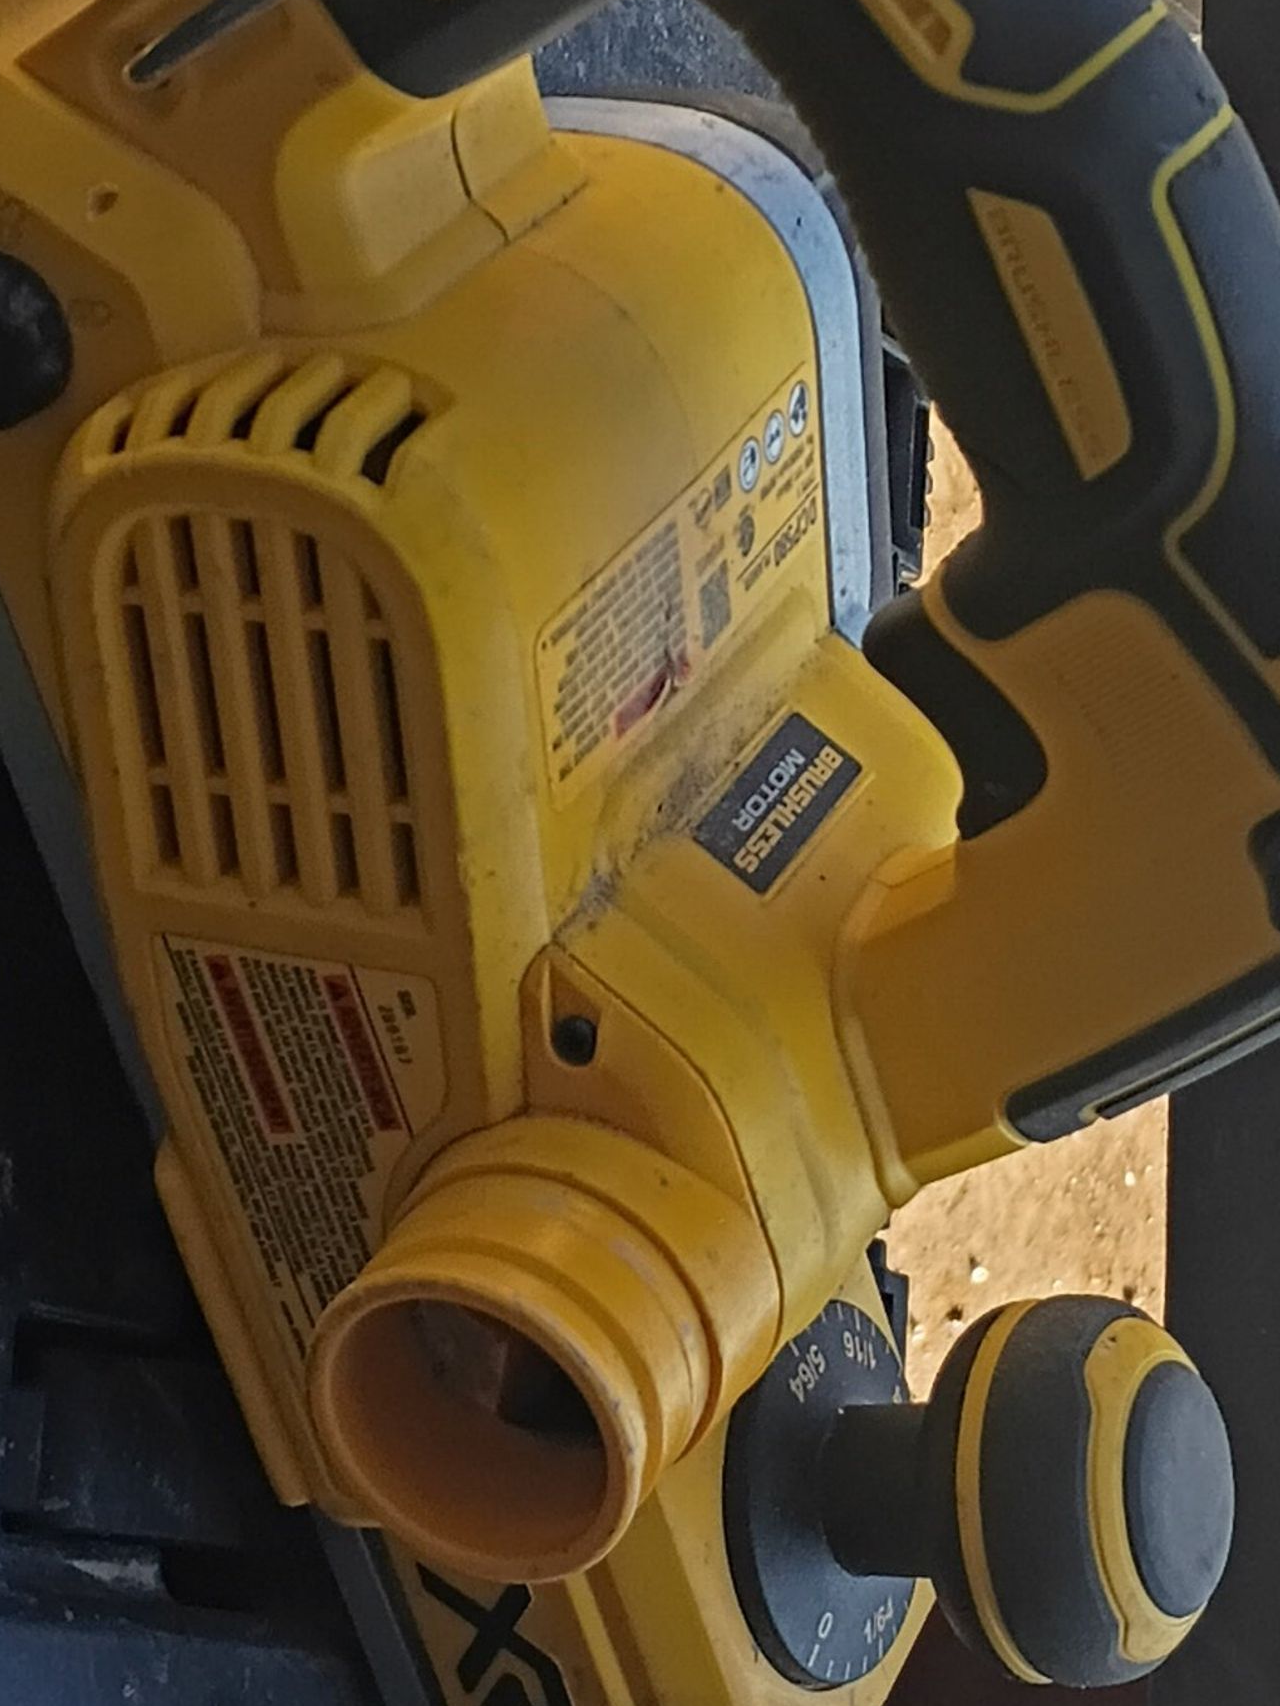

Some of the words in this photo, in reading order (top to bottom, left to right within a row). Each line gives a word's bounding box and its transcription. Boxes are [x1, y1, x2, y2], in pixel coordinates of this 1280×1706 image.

[732, 748, 807, 833] MOTOR
[733, 744, 845, 874] BRUSHLESS
[789, 1344, 826, 1404] 5/64
[843, 1330, 877, 1370] 1/16
[818, 1612, 834, 1639] 0
[863, 1597, 894, 1646] 1/64
